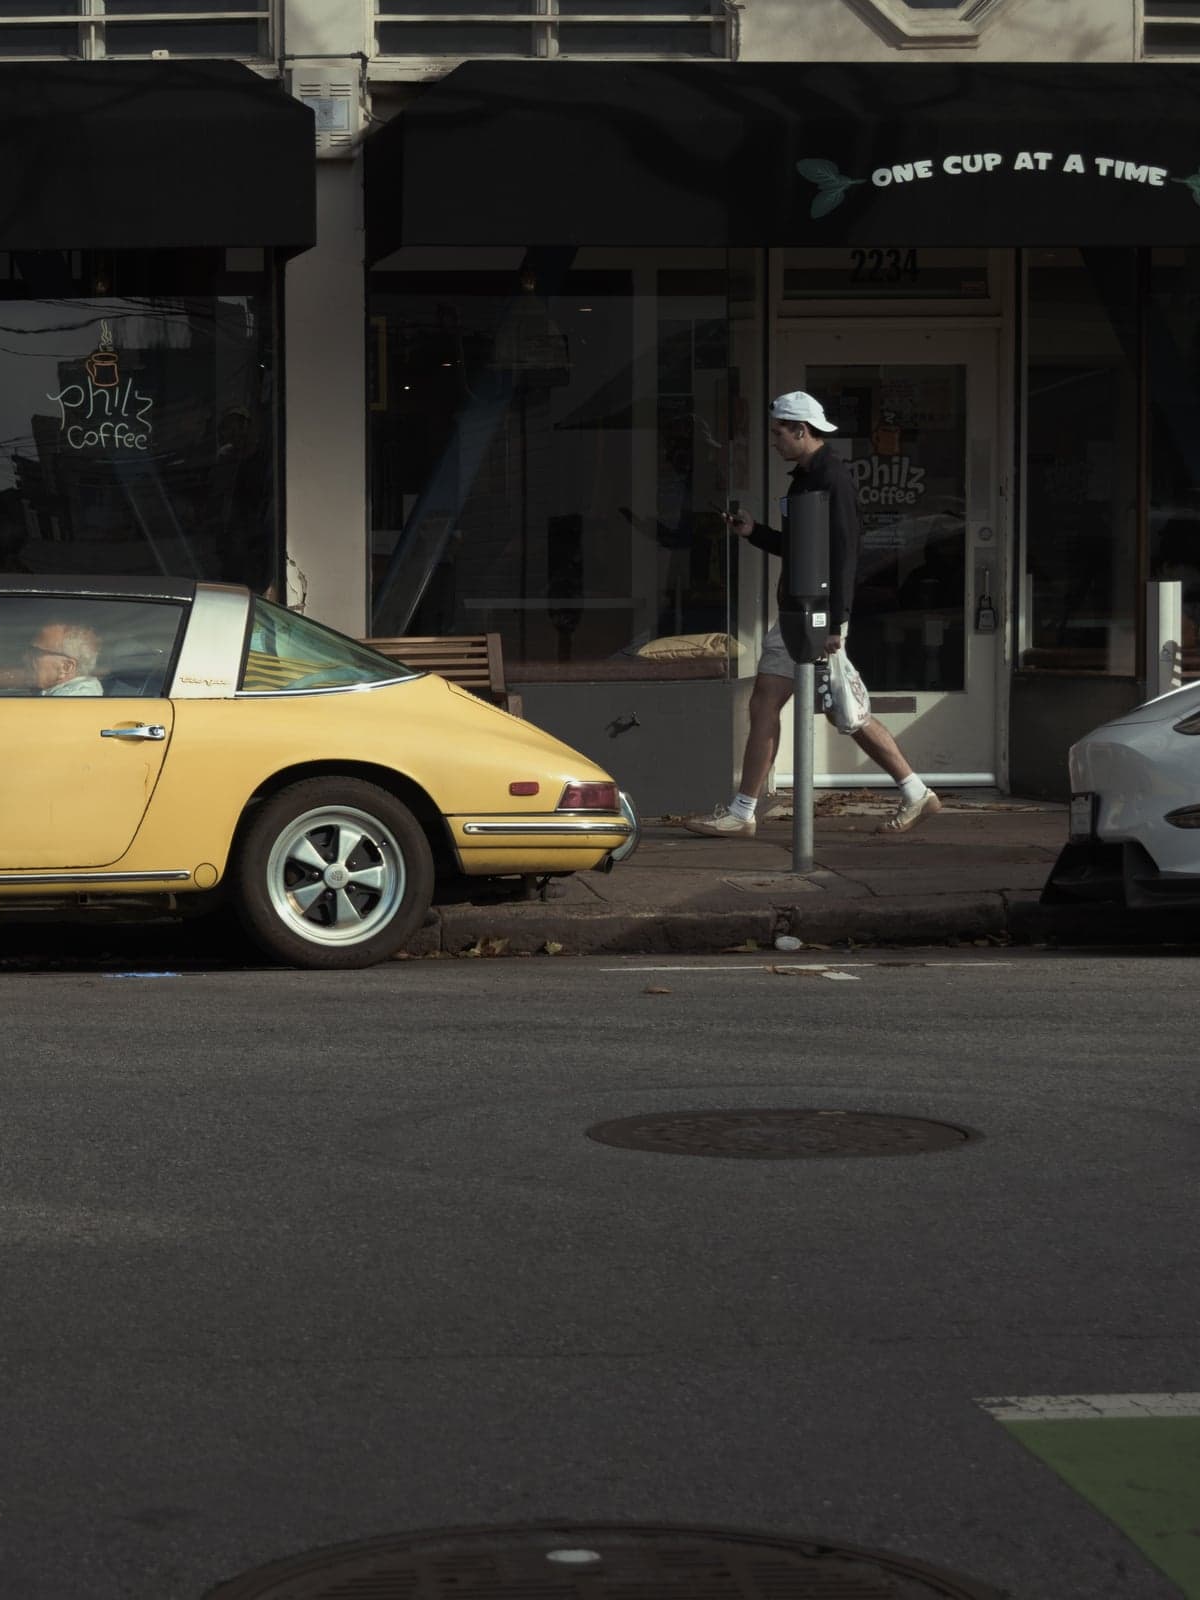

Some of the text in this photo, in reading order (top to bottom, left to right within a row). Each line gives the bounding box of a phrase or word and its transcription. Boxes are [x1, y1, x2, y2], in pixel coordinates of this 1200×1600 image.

[871, 152, 1168, 187] ONE CUP AT A TIME
[850, 249, 919, 282] 2234
[850, 455, 926, 494] Philz
[858, 485, 918, 505] Coffee
